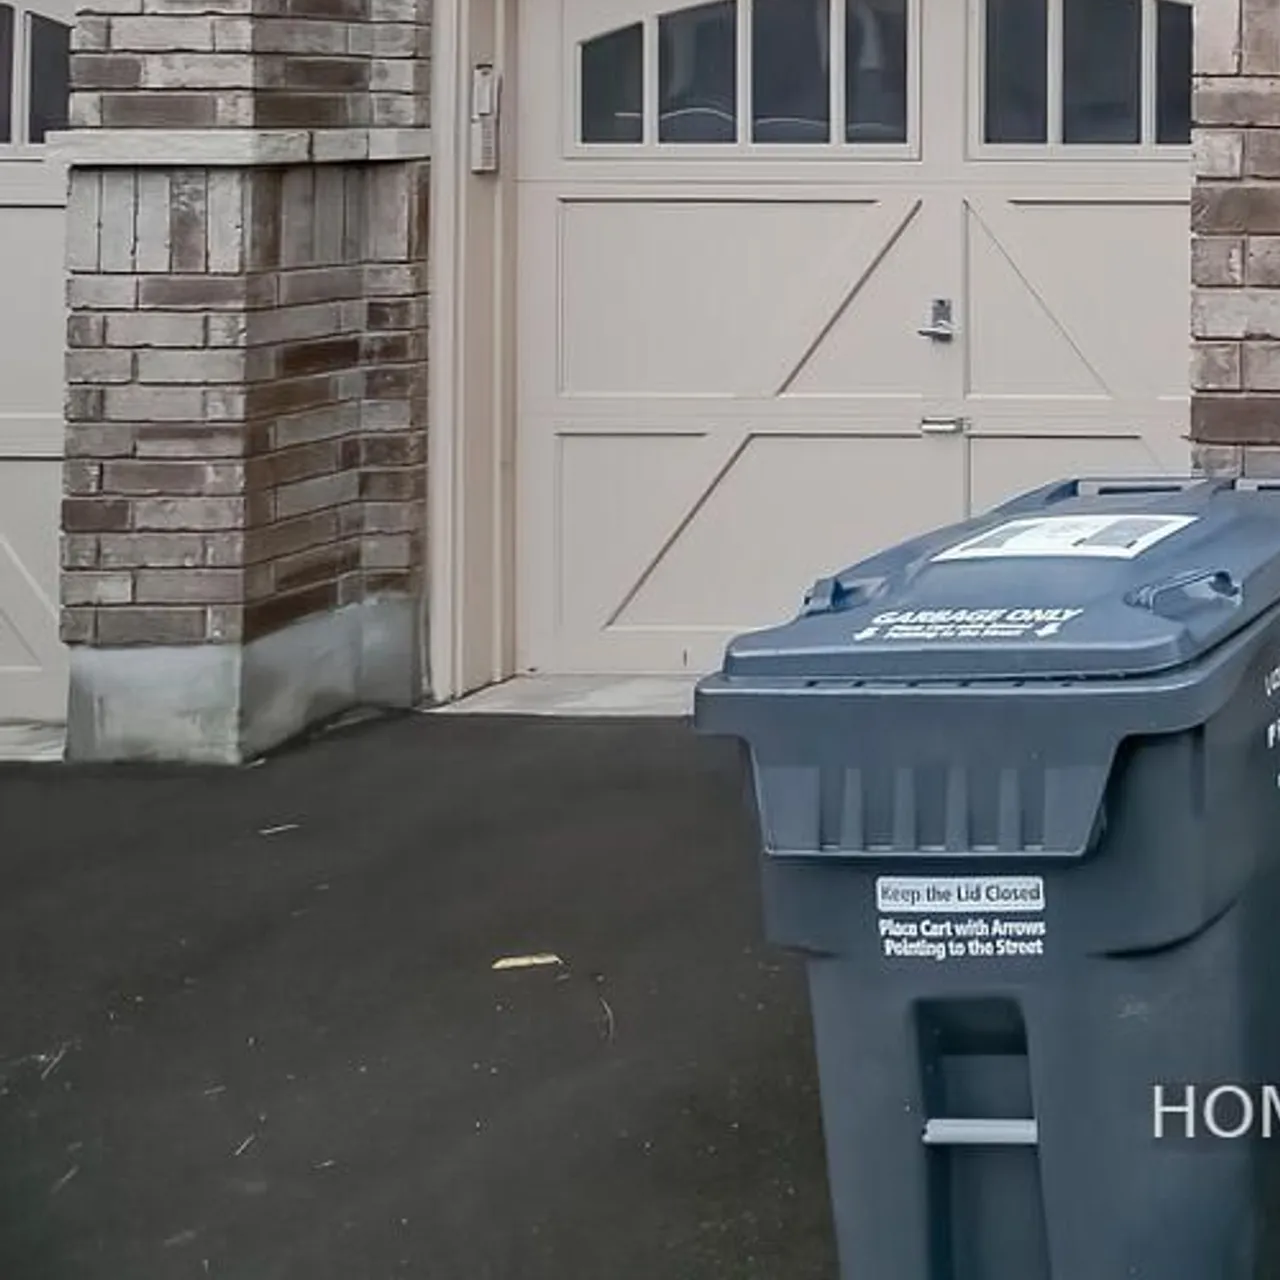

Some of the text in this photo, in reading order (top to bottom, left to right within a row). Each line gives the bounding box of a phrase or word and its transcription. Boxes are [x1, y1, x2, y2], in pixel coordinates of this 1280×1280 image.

[871, 607, 1084, 625] GARBAGE ONLY
[880, 884, 1040, 904] Keep the Lid Closed
[920, 919, 953, 936] Cart
[954, 919, 989, 936] with
[991, 919, 1046, 936] Arrows
[884, 938, 1044, 960] Pointing to the Street
